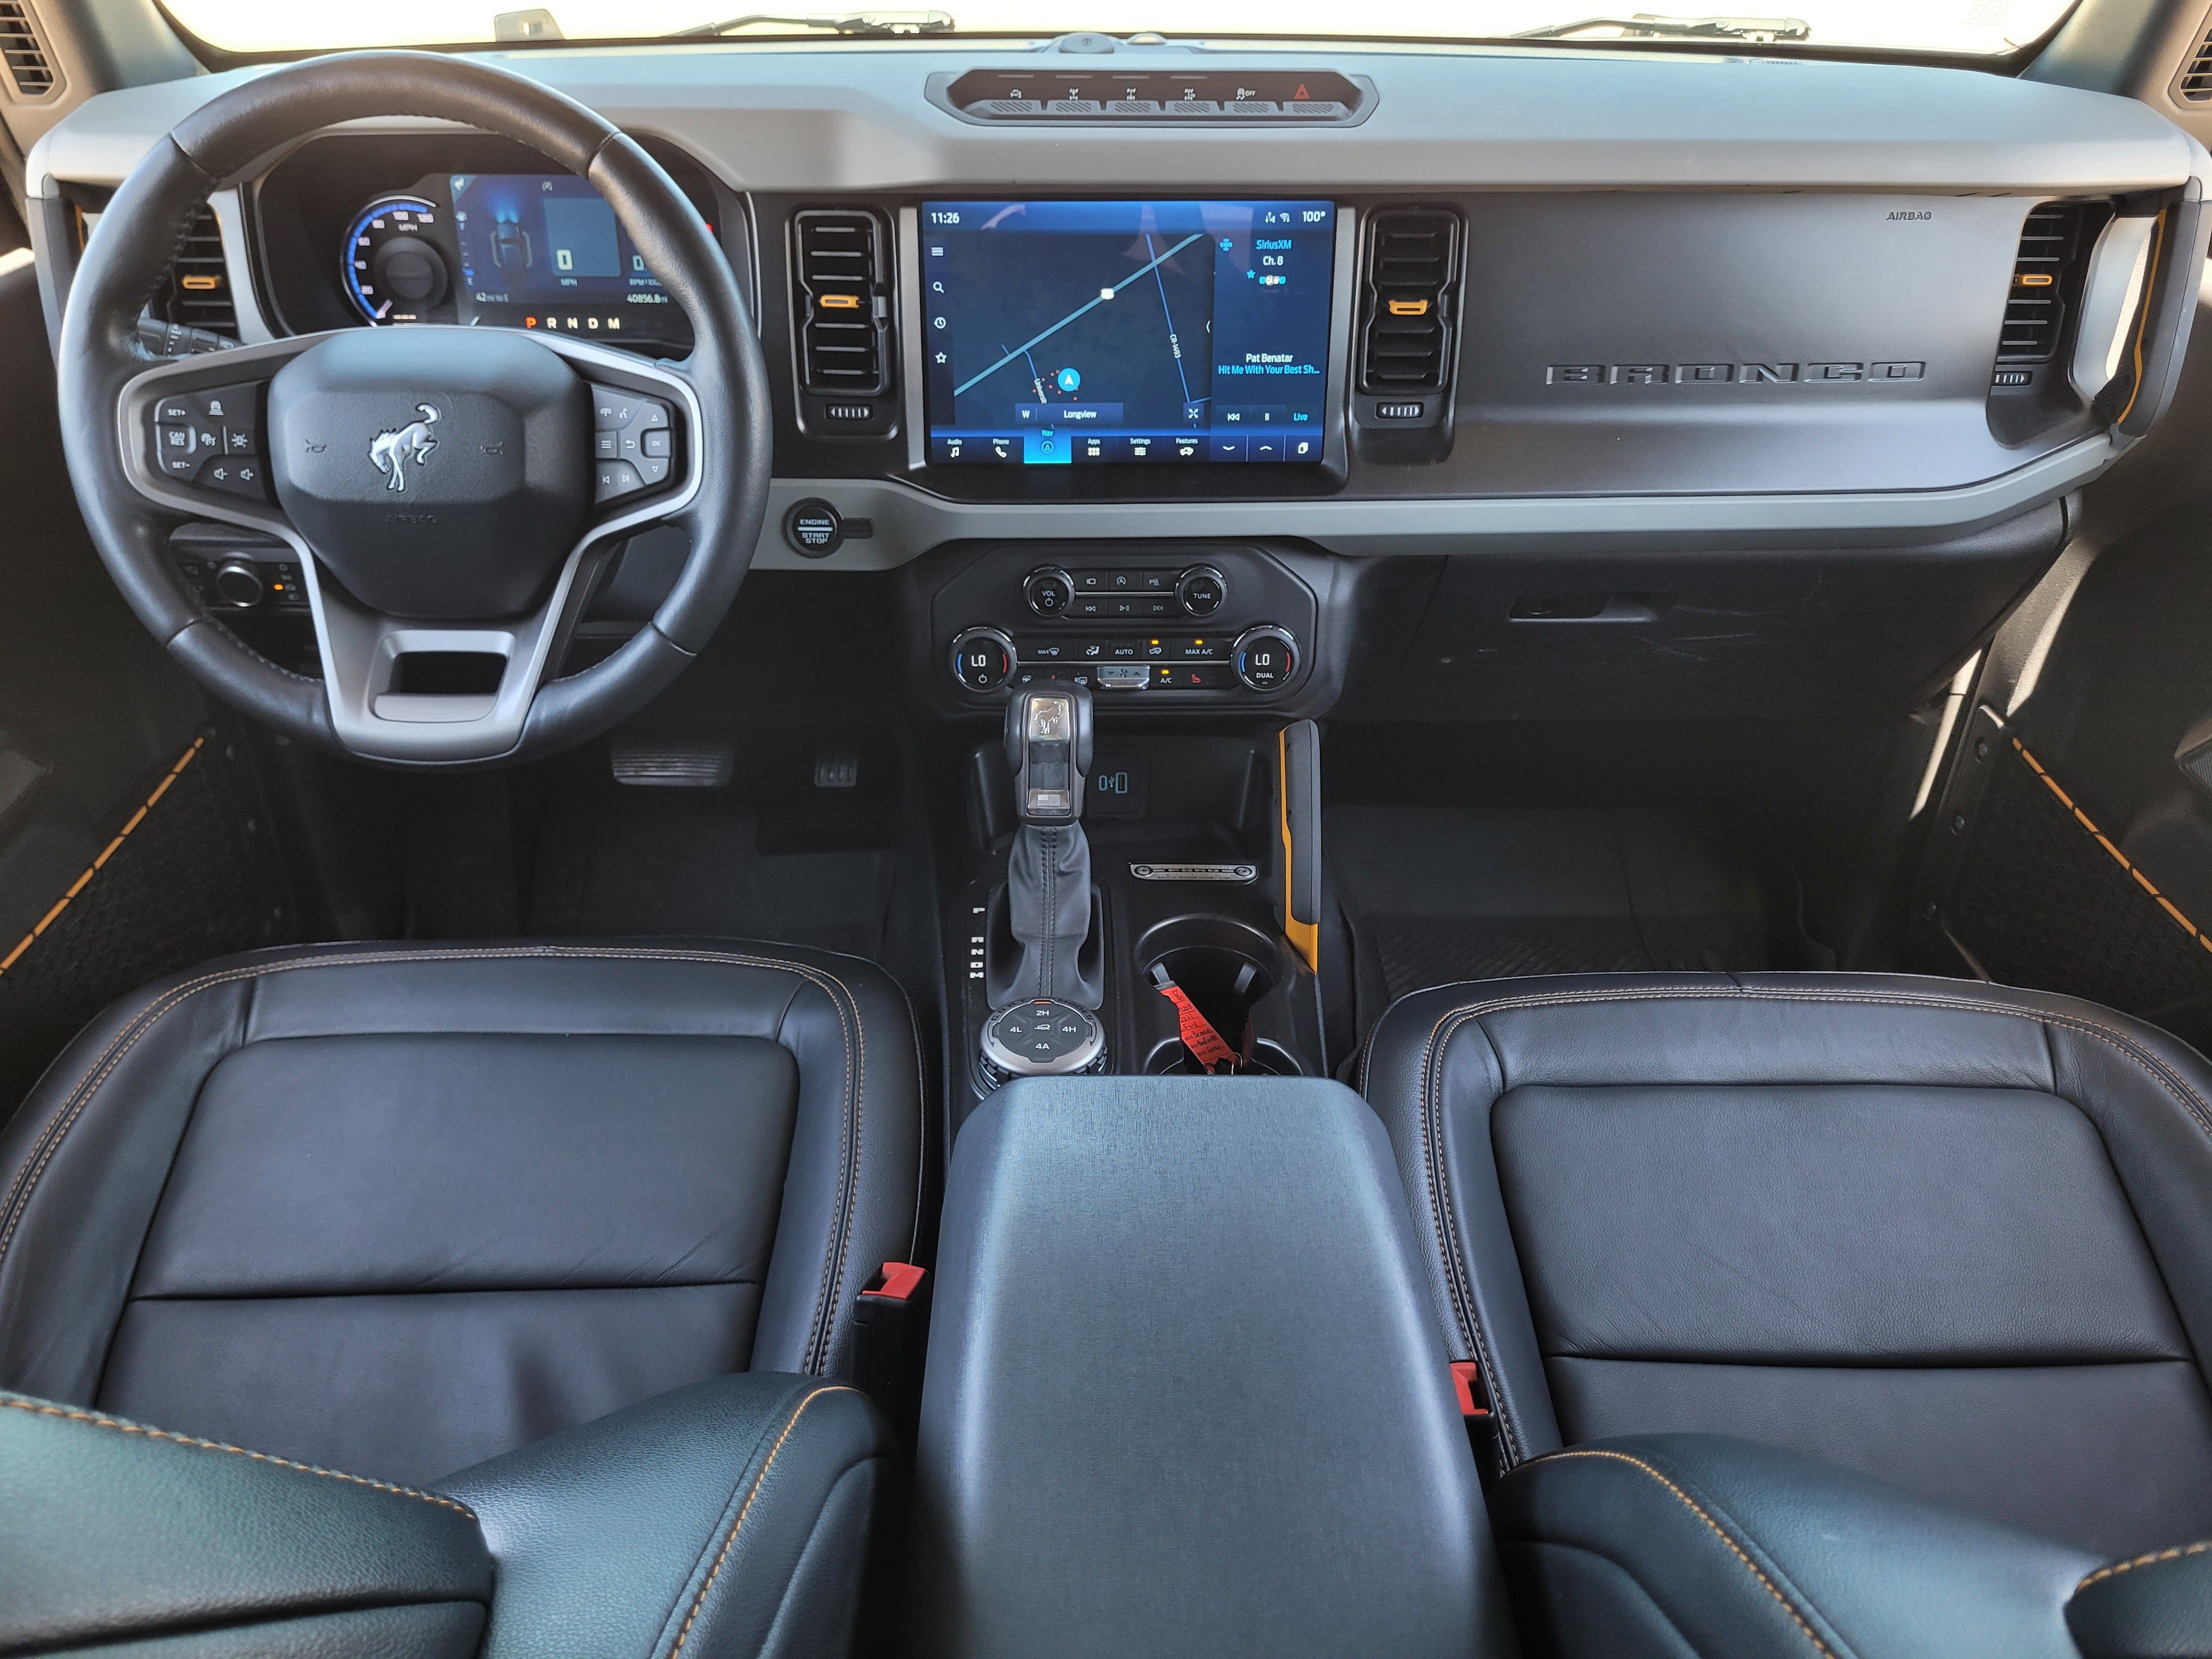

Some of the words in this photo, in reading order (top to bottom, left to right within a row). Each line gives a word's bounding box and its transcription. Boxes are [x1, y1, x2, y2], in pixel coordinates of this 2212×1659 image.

[931, 212, 960, 224] 11:26
[1886, 211, 1932, 221] AIRBAG
[1256, 239, 1292, 250] SiriusXM
[1277, 256, 1284, 266] 8
[526, 316, 537, 329] P
[546, 317, 557, 329] R
[567, 317, 578, 329] N
[587, 317, 599, 329] D
[607, 317, 620, 329] M
[1246, 353, 1260, 363] Pat
[1261, 353, 1294, 363] Benatar
[1218, 365, 1231, 375] Hit
[1231, 365, 1244, 375] Me
[1245, 364, 1264, 375] With
[1265, 364, 1283, 375] Your
[1284, 364, 1302, 374] Best
[1545, 361, 1926, 385] BRONCO
[1022, 410, 1030, 419] W
[1064, 410, 1097, 420] Longview
[1294, 413, 1308, 421] Live
[971, 654, 986, 667] LO
[1255, 653, 1270, 666] LO
